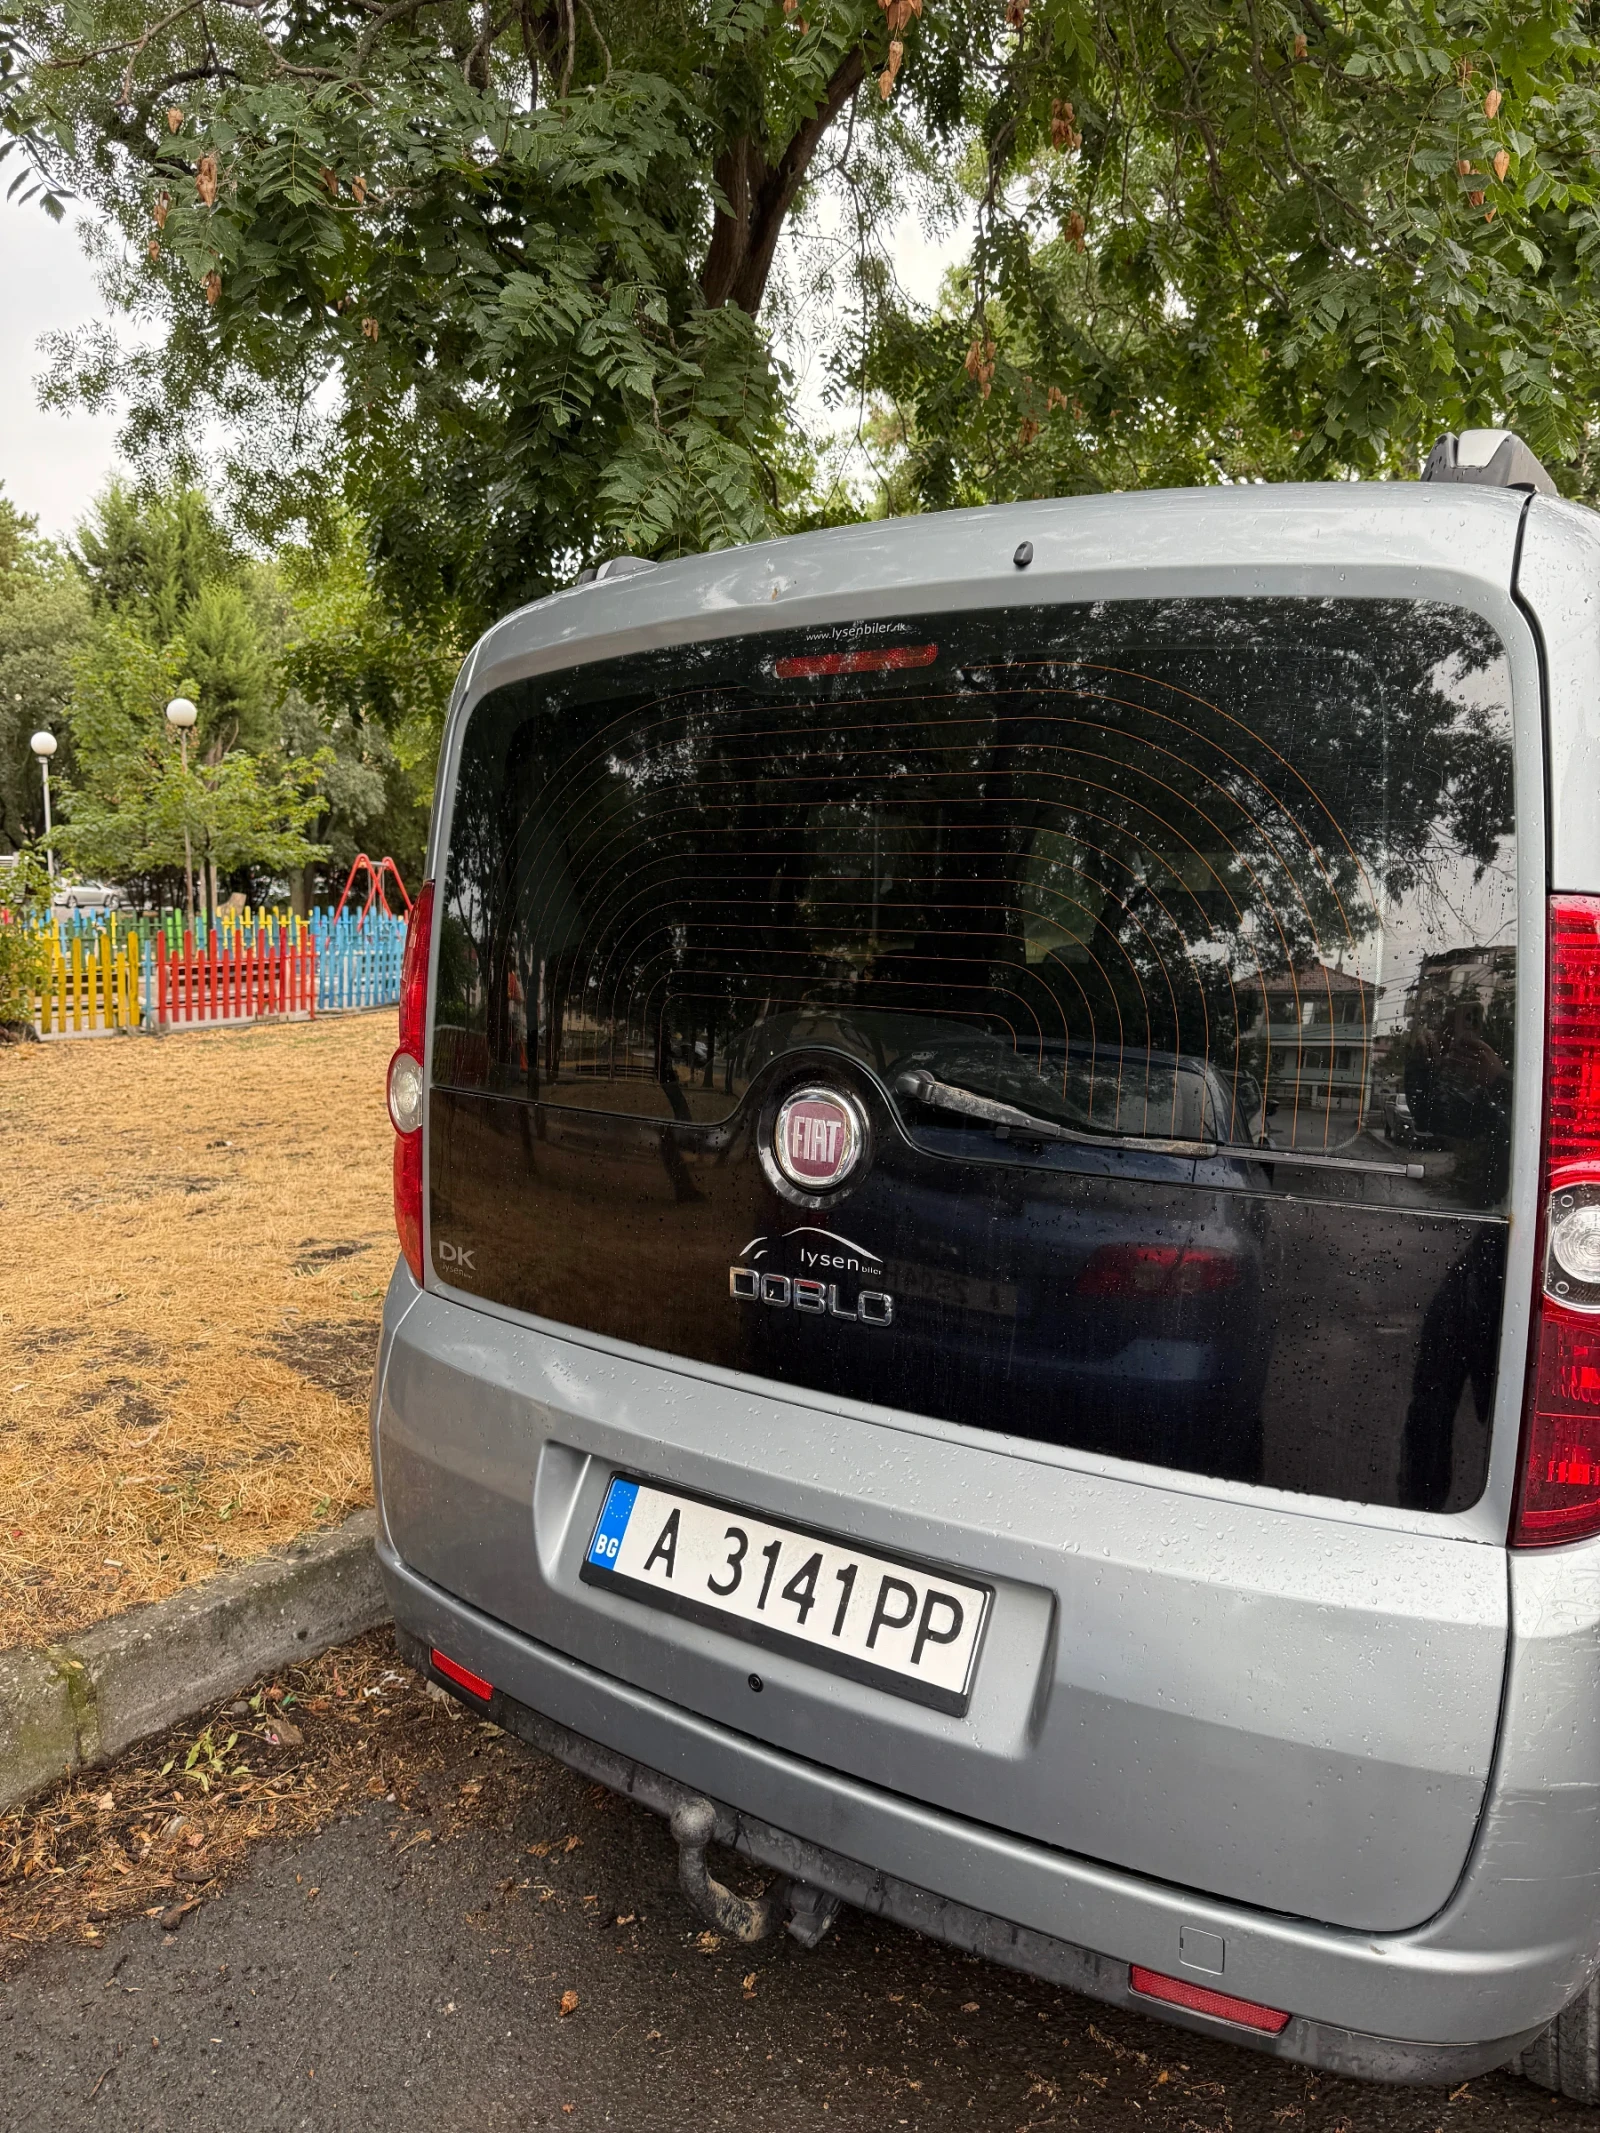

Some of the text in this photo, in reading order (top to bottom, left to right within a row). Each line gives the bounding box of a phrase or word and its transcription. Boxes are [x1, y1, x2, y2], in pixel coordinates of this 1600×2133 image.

[791, 1115, 843, 1164] FIAT
[438, 1240, 477, 1271] DK
[801, 1248, 859, 1271] lysen
[729, 1266, 894, 1327] DOBLO
[595, 1533, 620, 1558] BG
[643, 1508, 964, 1666] A 3141PP
